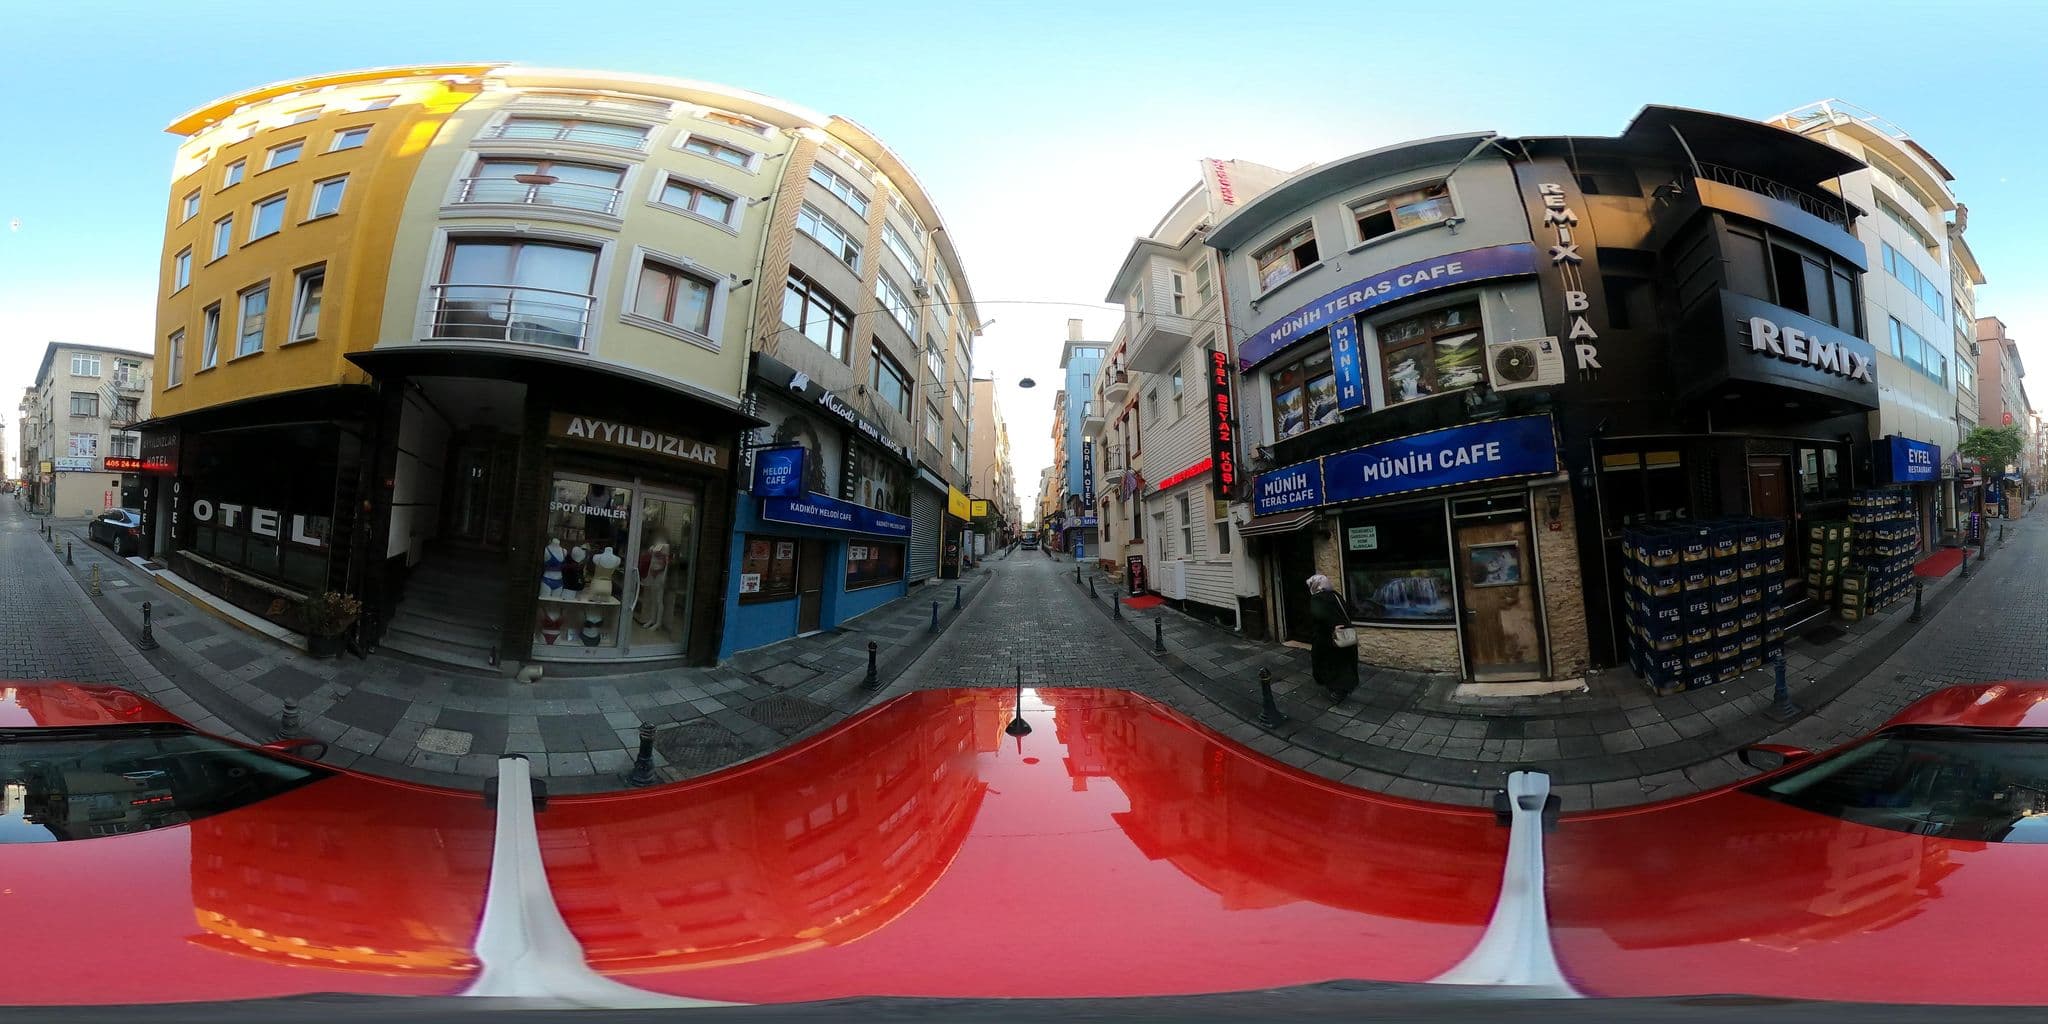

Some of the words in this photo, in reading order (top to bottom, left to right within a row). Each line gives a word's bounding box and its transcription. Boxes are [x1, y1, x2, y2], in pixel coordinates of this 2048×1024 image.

[1270, 308, 1320, 344] MÜNİH
[1325, 280, 1391, 313] TERAS
[1397, 261, 1464, 288] CAFE
[1566, 290, 1601, 369] BAR
[1336, 326, 1355, 399] MÜNİH
[1750, 317, 1873, 382] REMIX
[1215, 352, 1225, 385] OTEL
[1217, 394, 1230, 441] BEYAZ
[567, 417, 717, 464] AYYILDIZLAR
[1908, 448, 1931, 464] EYFEL
[766, 475, 786, 485] CAFE
[1363, 451, 1432, 482] MÜNİH
[1439, 441, 1501, 469] CAFE
[1261, 487, 1287, 509] TERAS
[1289, 489, 1314, 503] CAFE
[1265, 472, 1306, 496] MÜNİH
[142, 488, 150, 536] OTEL
[171, 481, 181, 538] OTEL
[193, 499, 321, 547] OTEL
[550, 501, 576, 513] SPOT
[580, 503, 626, 520] ÜRÜNLER
[790, 502, 819, 515] KADIKÖY
[839, 512, 852, 521] CAFE
[1659, 608, 1679, 618] EFES
[1690, 602, 1708, 612] EFES
[1662, 658, 1680, 669] EFES
